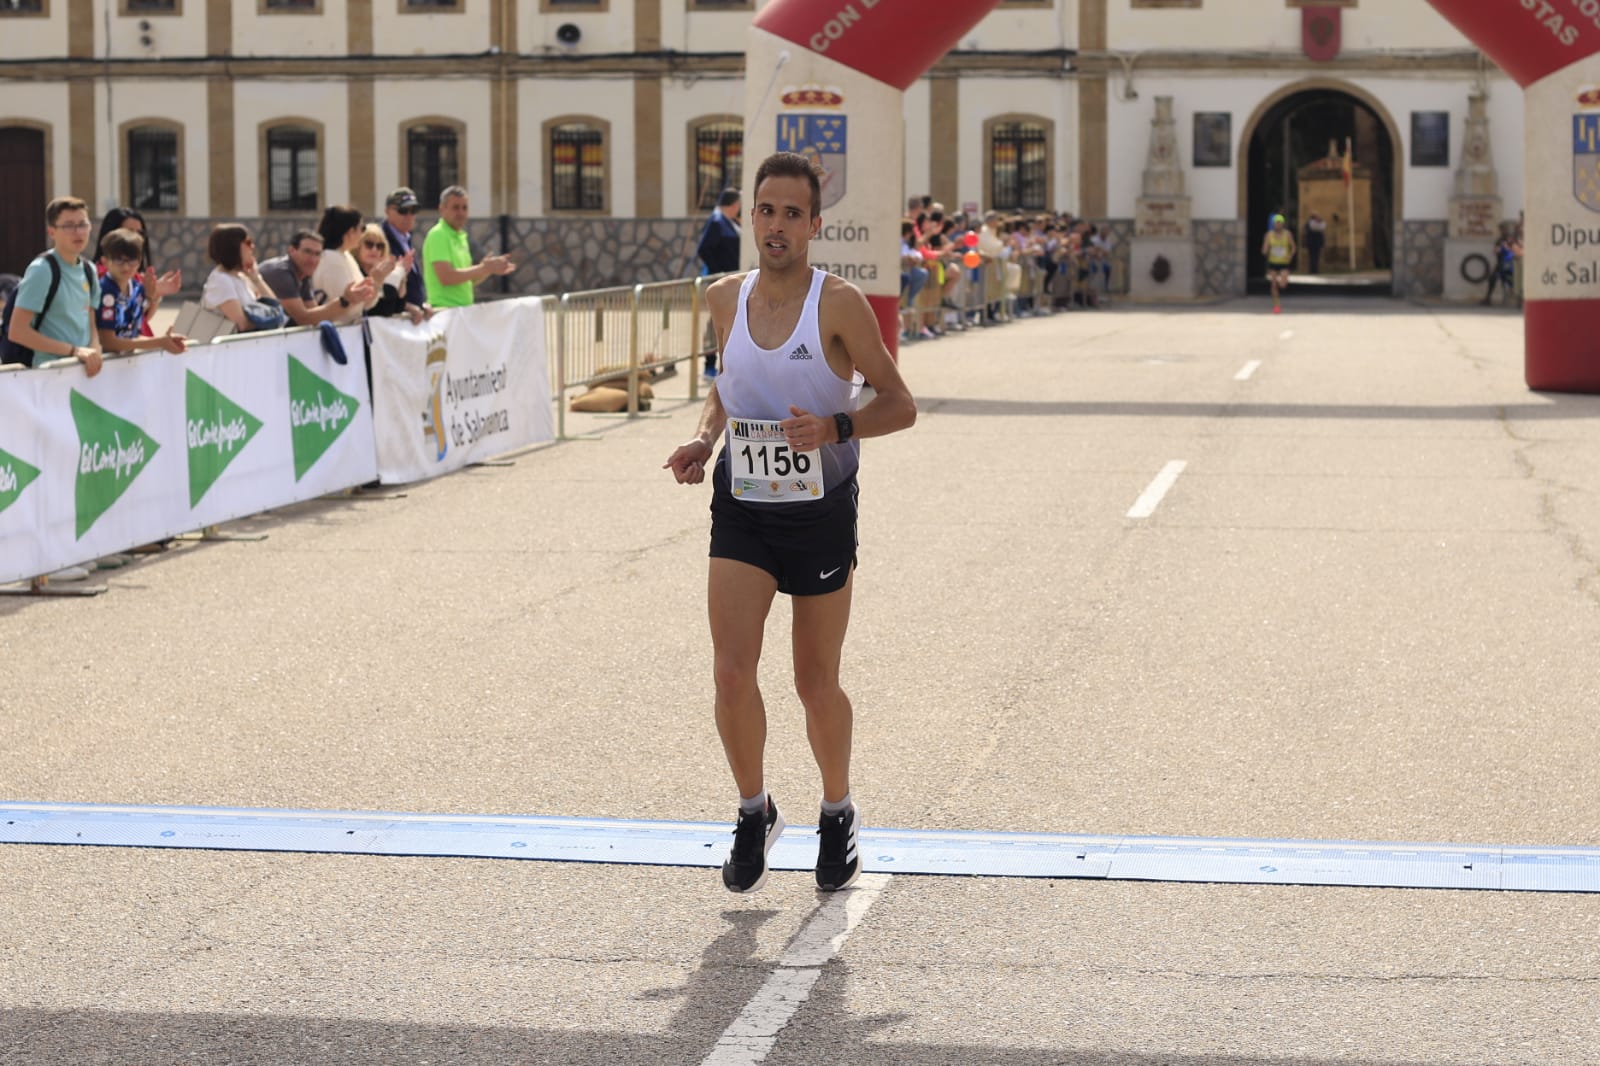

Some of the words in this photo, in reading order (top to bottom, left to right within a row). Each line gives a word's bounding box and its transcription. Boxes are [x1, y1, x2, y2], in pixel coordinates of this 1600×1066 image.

[809, 4, 861, 53] CON
[1551, 222, 1600, 252] Dipu
[811, 262, 877, 280] manca
[1541, 266, 1559, 286] de
[1565, 260, 1600, 285] Sal
[450, 415, 464, 447] de
[733, 421, 749, 438] XII
[741, 444, 811, 477] 1156
